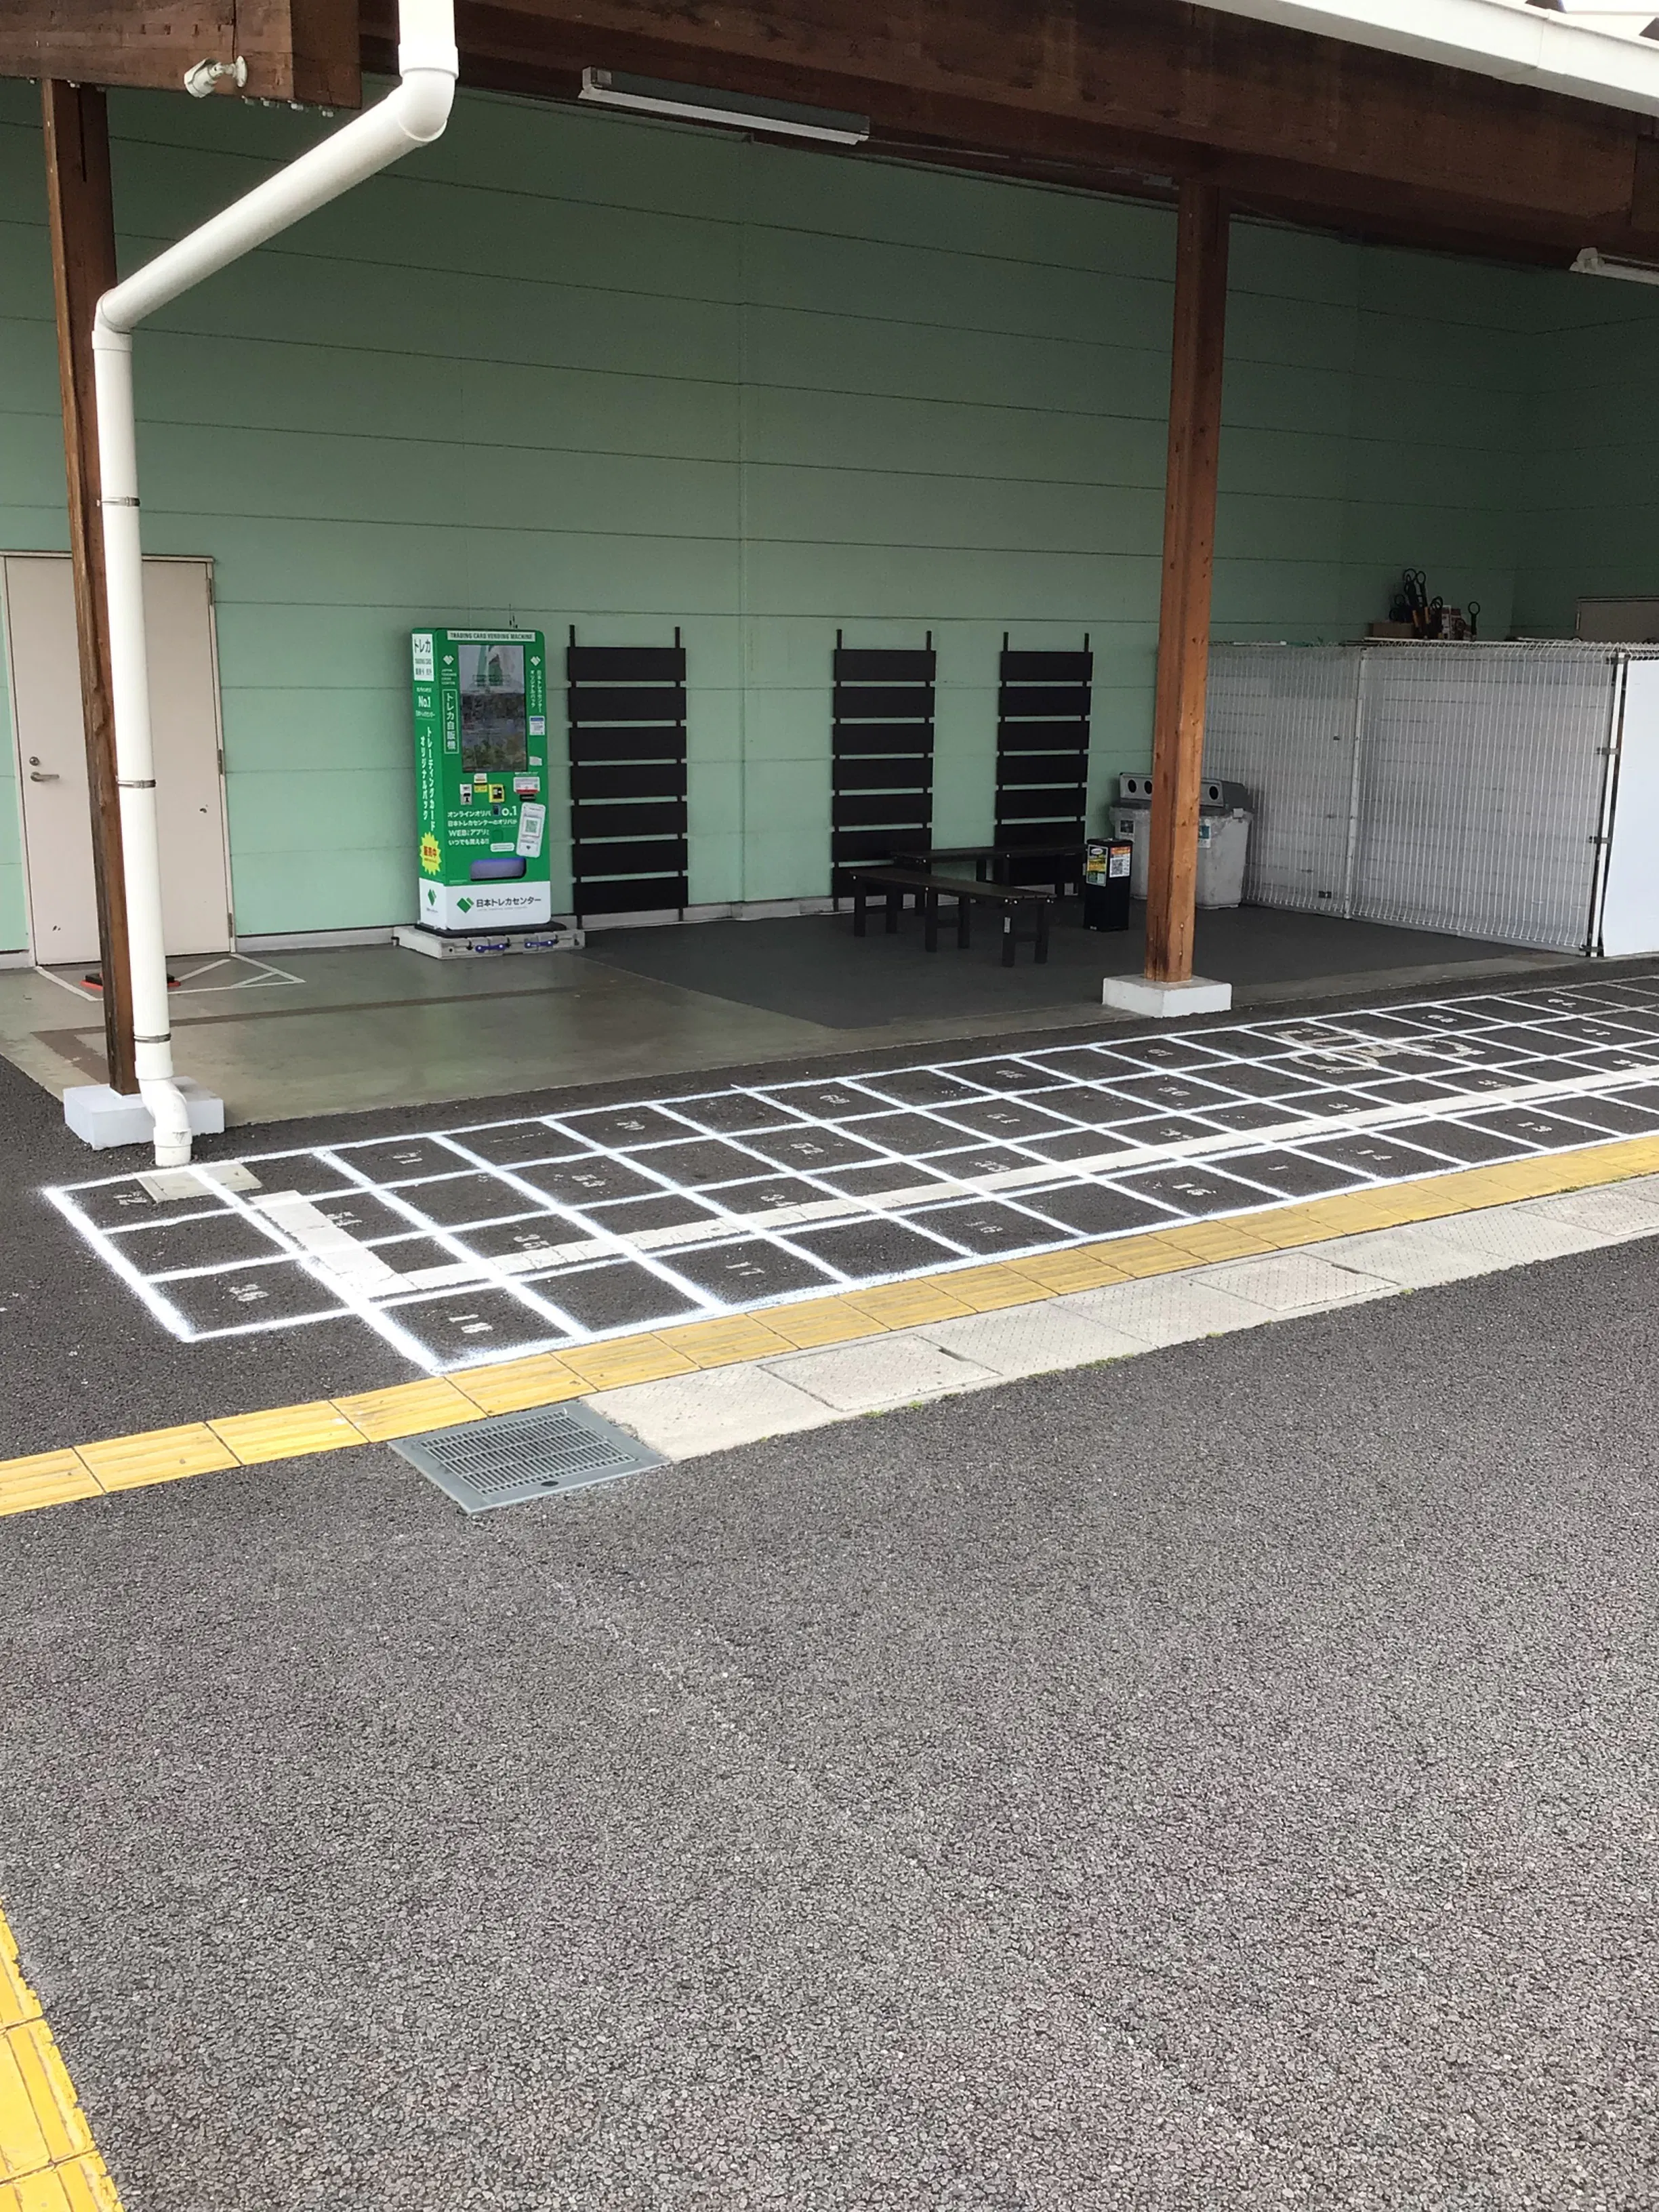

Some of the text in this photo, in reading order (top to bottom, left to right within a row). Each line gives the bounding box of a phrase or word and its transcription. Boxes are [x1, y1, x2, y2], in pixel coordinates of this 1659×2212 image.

[414, 639, 431, 654] トレカ
[418, 695, 431, 708] No.1
[446, 693, 456, 750] トレカ自販機
[427, 726, 436, 832] トレーディングカード
[476, 897, 541, 908] 日本トレカセンター
[987, 1113, 1020, 1124] 51
[790, 1142, 824, 1155] 52
[392, 1151, 422, 1164] 71
[572, 1174, 607, 1188] 53
[760, 1193, 798, 1208] 34
[513, 1234, 550, 1249] 35
[726, 1261, 765, 1276] 17
[229, 1284, 268, 1302] 36
[448, 1313, 493, 1334] 18
